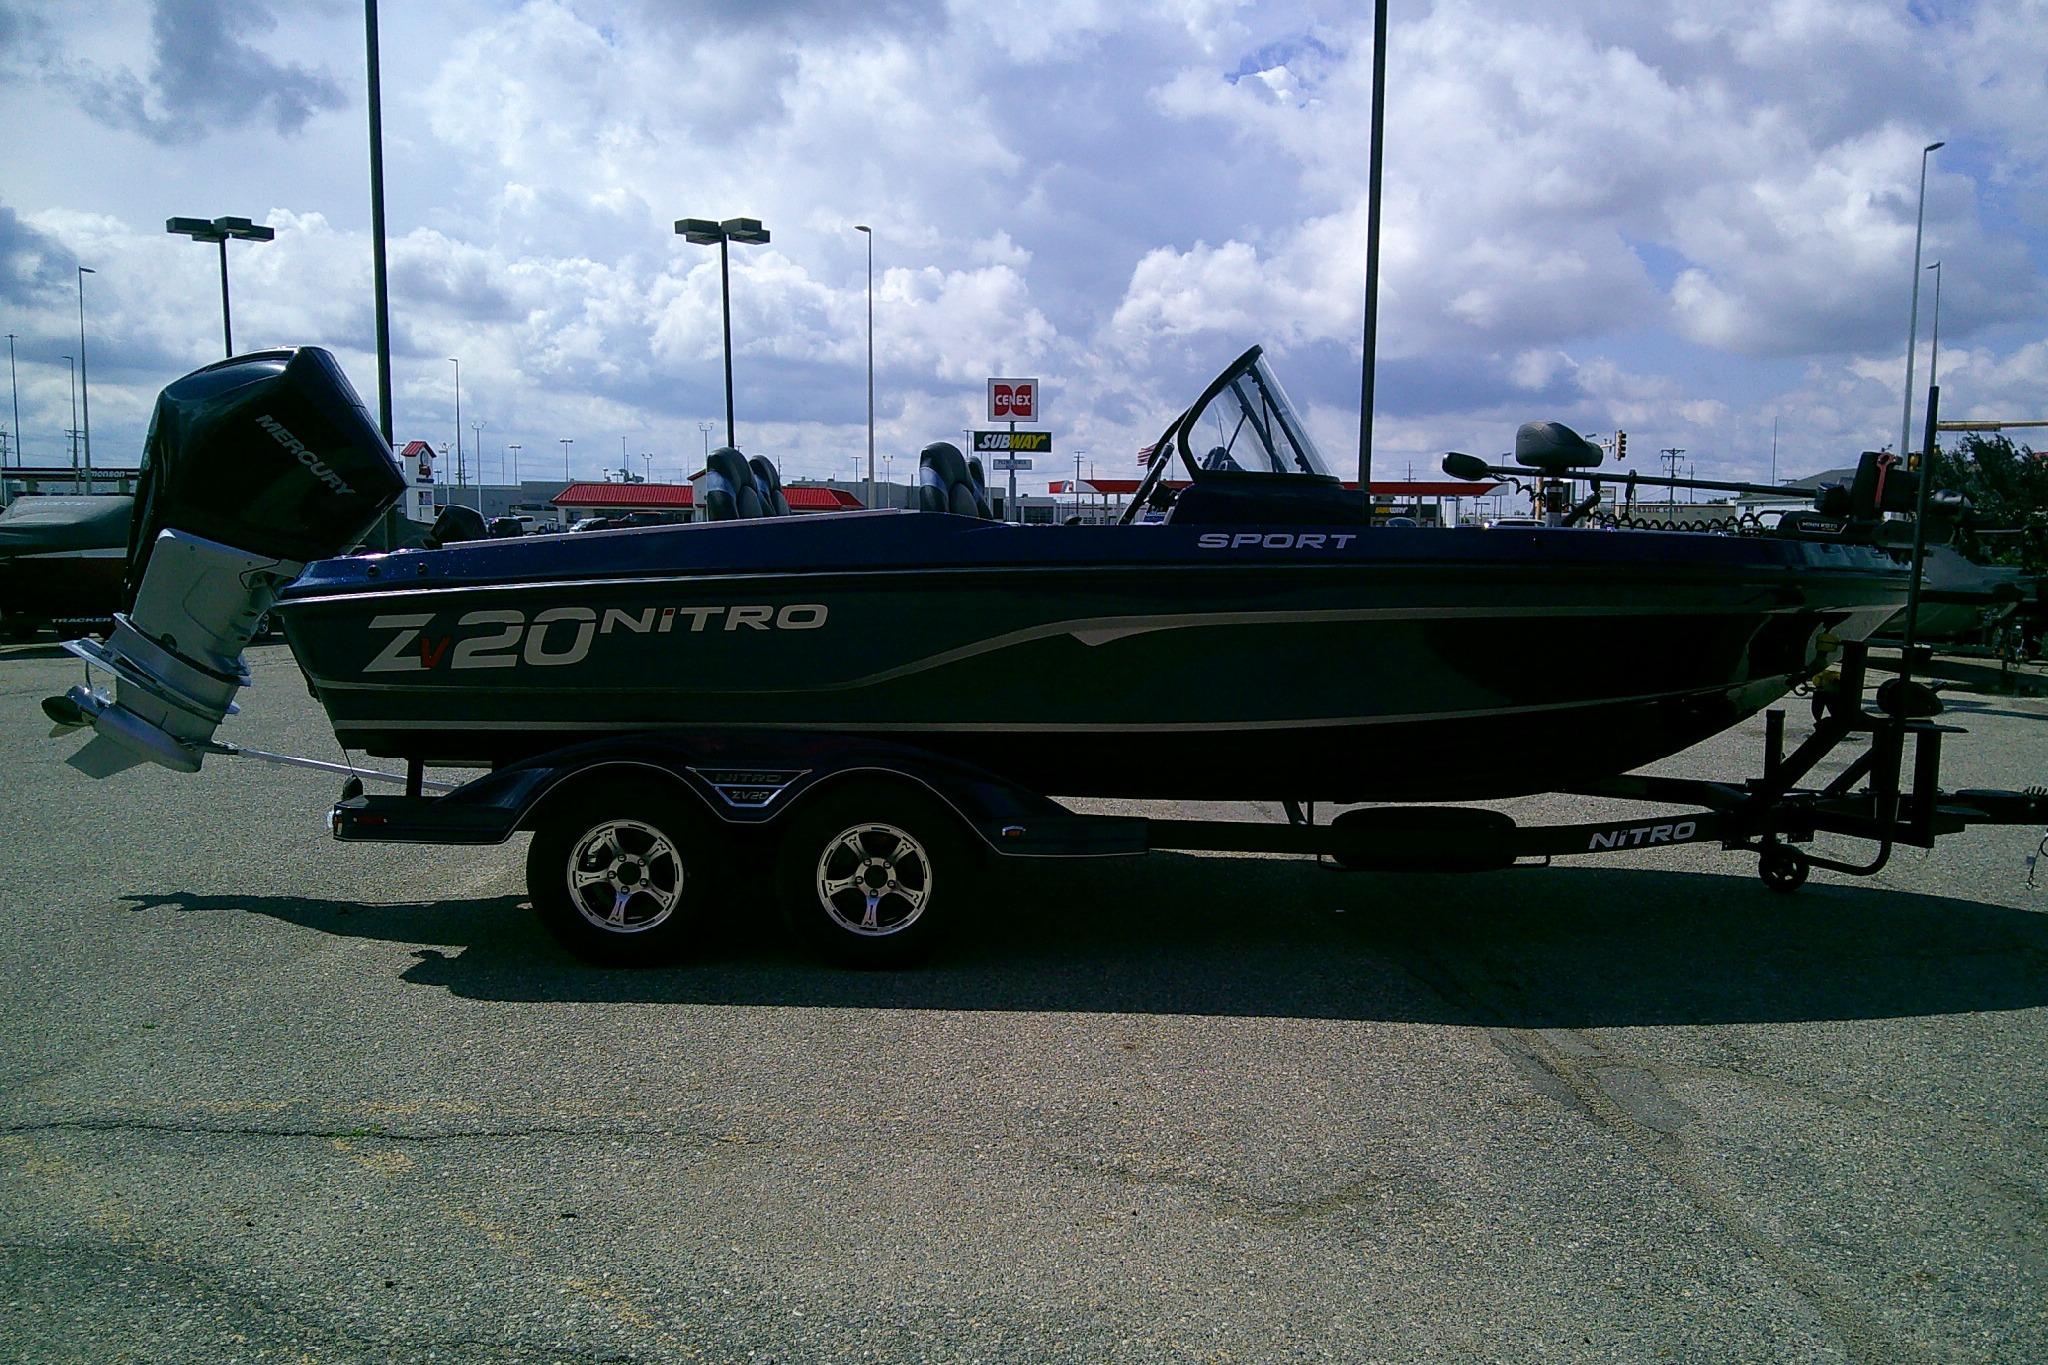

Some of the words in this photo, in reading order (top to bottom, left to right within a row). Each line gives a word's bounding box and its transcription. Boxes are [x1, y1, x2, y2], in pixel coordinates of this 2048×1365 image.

[995, 395, 1031, 406] CENEX
[979, 434, 1047, 449] SUBWAY
[255, 414, 356, 496] MERCURY
[81, 469, 126, 478] Smonson
[1198, 533, 1357, 549] SPORT
